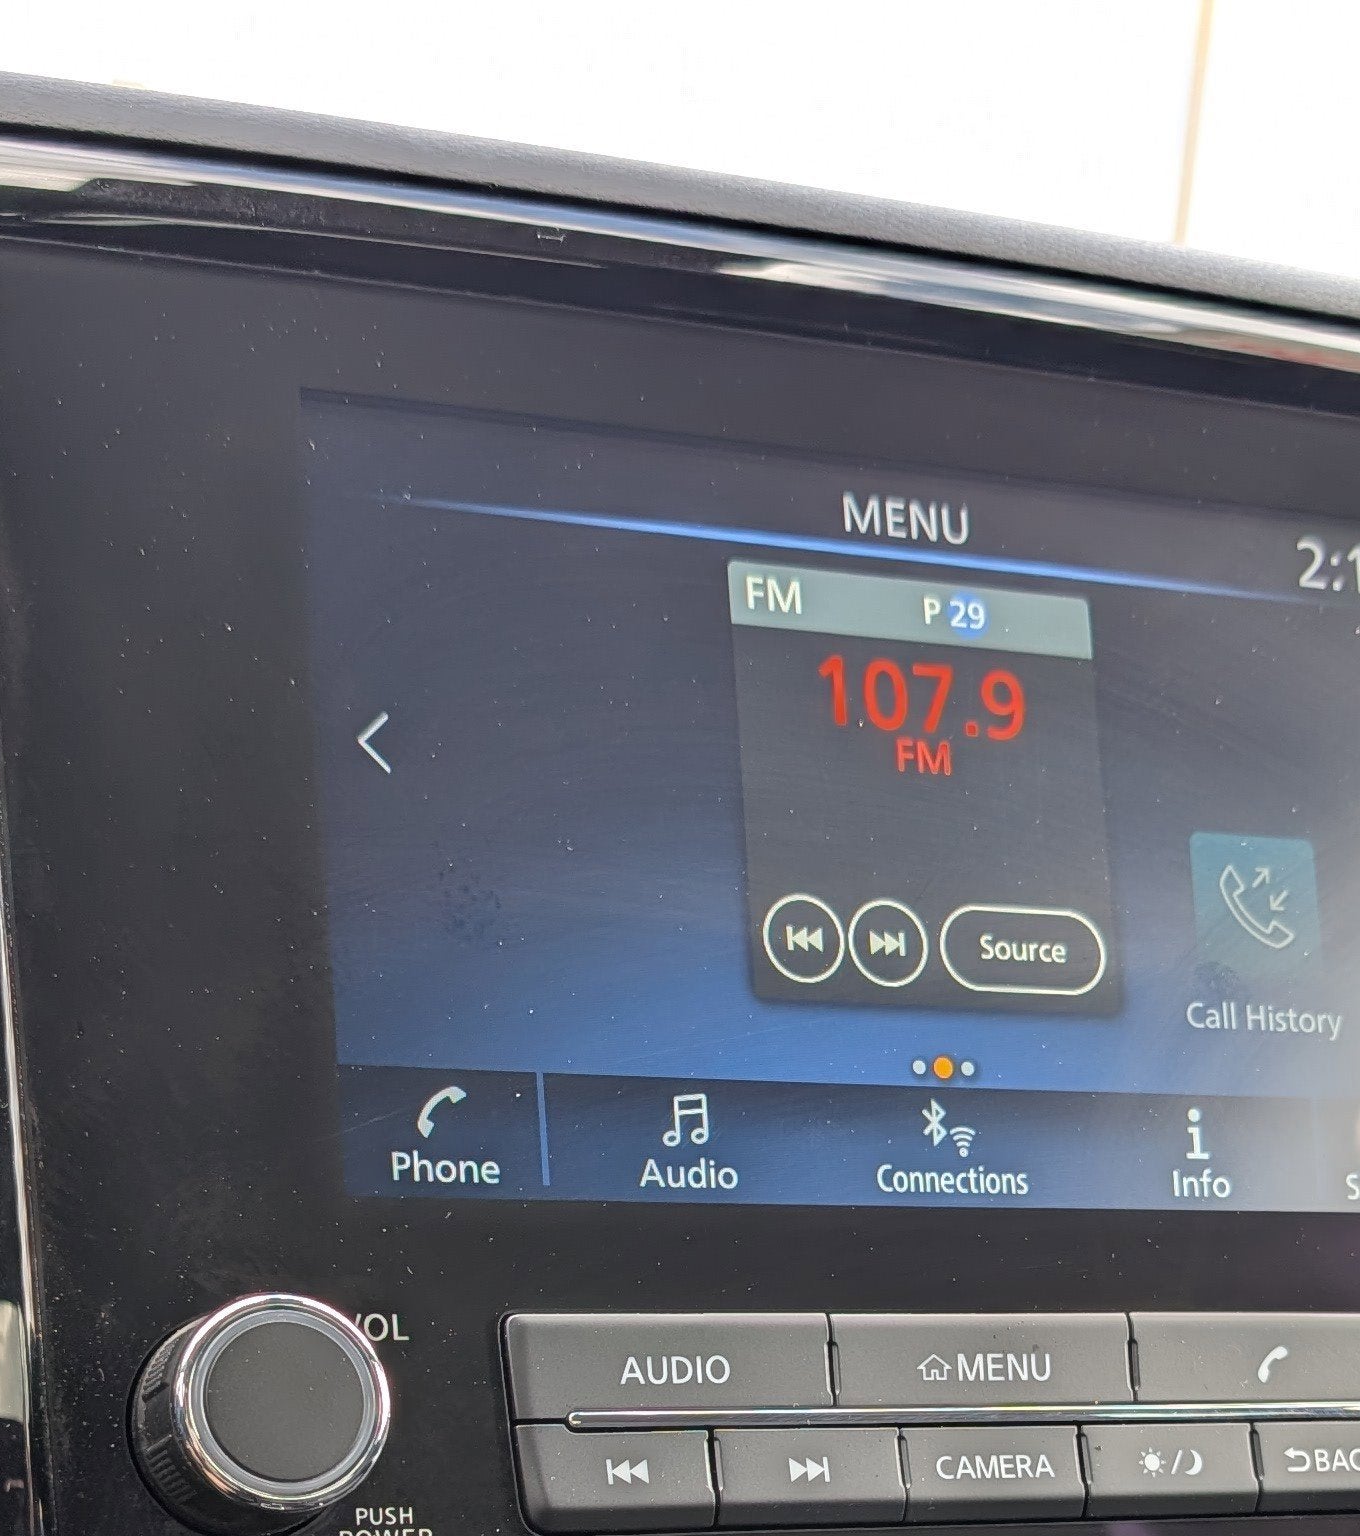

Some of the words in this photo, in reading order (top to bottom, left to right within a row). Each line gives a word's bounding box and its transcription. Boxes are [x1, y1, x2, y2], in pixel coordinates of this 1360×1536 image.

[842, 491, 970, 546] MENU
[744, 574, 803, 616] FM
[923, 597, 941, 626] P
[948, 599, 987, 632] 29
[817, 653, 1028, 741] 107.9
[896, 740, 952, 776] FM
[979, 934, 1067, 965] Source
[1185, 1001, 1238, 1032] Call
[1244, 1005, 1342, 1039] History
[390, 1150, 501, 1186] Phone
[639, 1157, 739, 1191] Audio
[875, 1163, 1030, 1197] Connections
[1172, 1167, 1232, 1199] Info
[619, 1355, 732, 1386] AUDIO
[956, 1353, 1053, 1383] MENU
[935, 1454, 1056, 1481] CAMERA
[354, 1507, 414, 1527] PUSH
